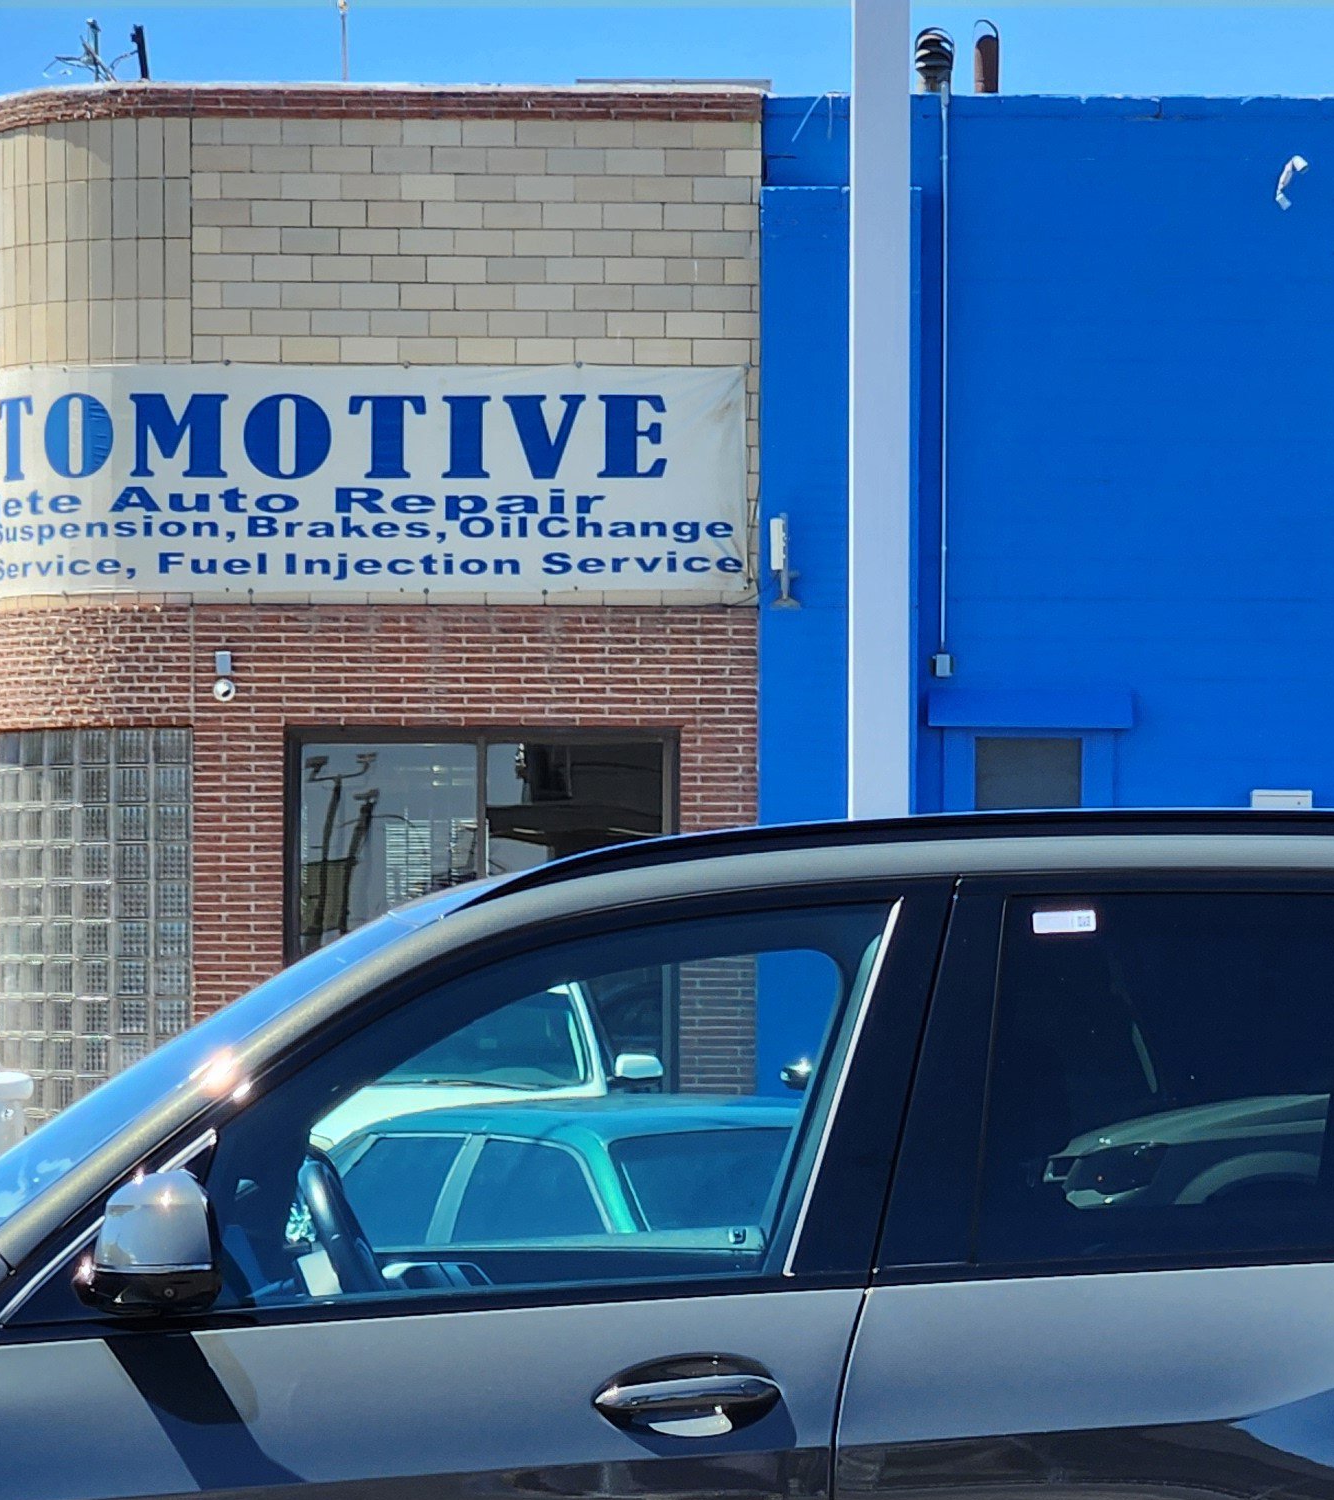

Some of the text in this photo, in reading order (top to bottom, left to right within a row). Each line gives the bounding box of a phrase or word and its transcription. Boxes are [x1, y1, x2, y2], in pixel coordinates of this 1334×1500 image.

[109, 486, 300, 514] Auto
[334, 487, 606, 521] Repair
[247, 515, 447, 544] Brakes,
[158, 553, 267, 575] Fuel
[285, 553, 520, 580] Injection
[542, 551, 743, 575] Service
